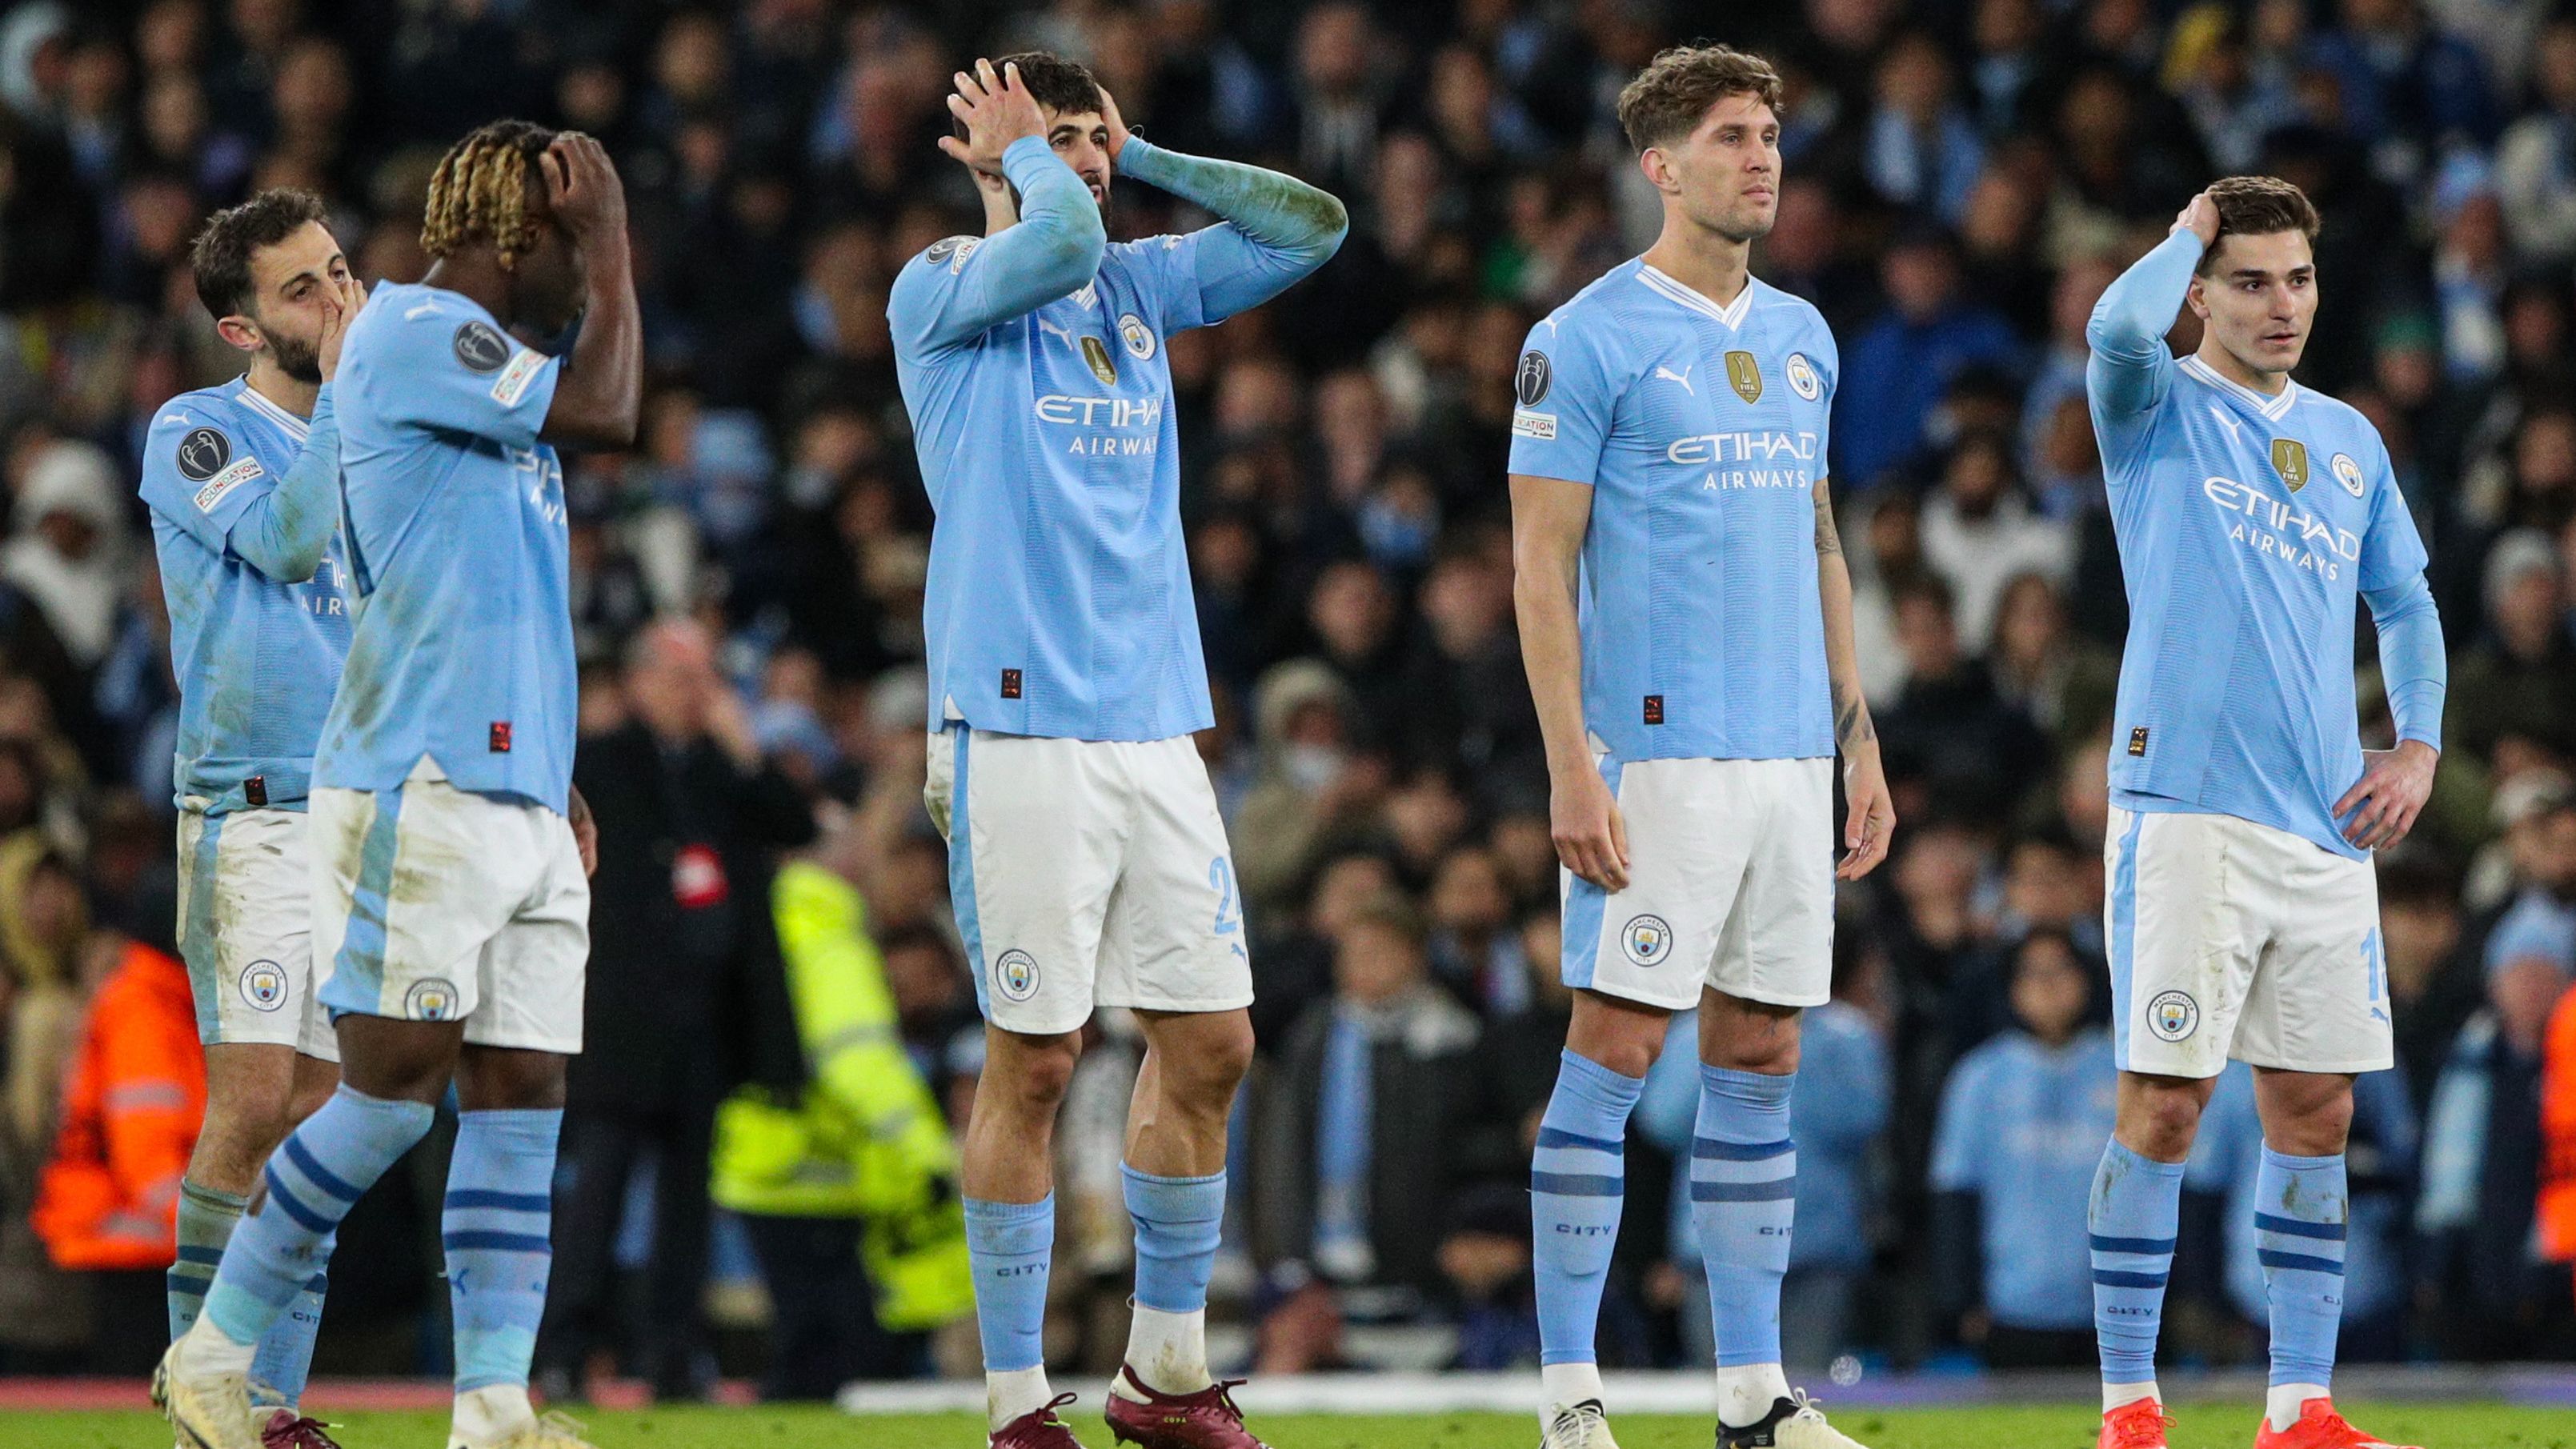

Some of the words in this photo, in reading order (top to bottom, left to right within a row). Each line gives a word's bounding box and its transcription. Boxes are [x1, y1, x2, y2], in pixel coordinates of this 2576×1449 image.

[1035, 394, 1164, 426] ETIHA
[1668, 431, 1817, 464] ETIHAD
[198, 462, 259, 507] FOUNDATION
[1703, 470, 1807, 490] AIRWAYS
[2282, 472, 2299, 481] FIFA
[2204, 476, 2360, 561] ETIHAD
[2229, 524, 2339, 582] AIRWAYS
[1209, 856, 1243, 935] 2
[1628, 918, 1668, 937] MANCHESTER
[2360, 927, 2390, 1002] 1
[2153, 995, 2194, 1011] MANCHESTER
[1555, 1224, 1611, 1235] CITY
[1759, 1227, 1793, 1236] CIT
[996, 1263, 1048, 1277] CITY
[292, 1311, 320, 1325] CIT
[2107, 1307, 2153, 1315] CITY
